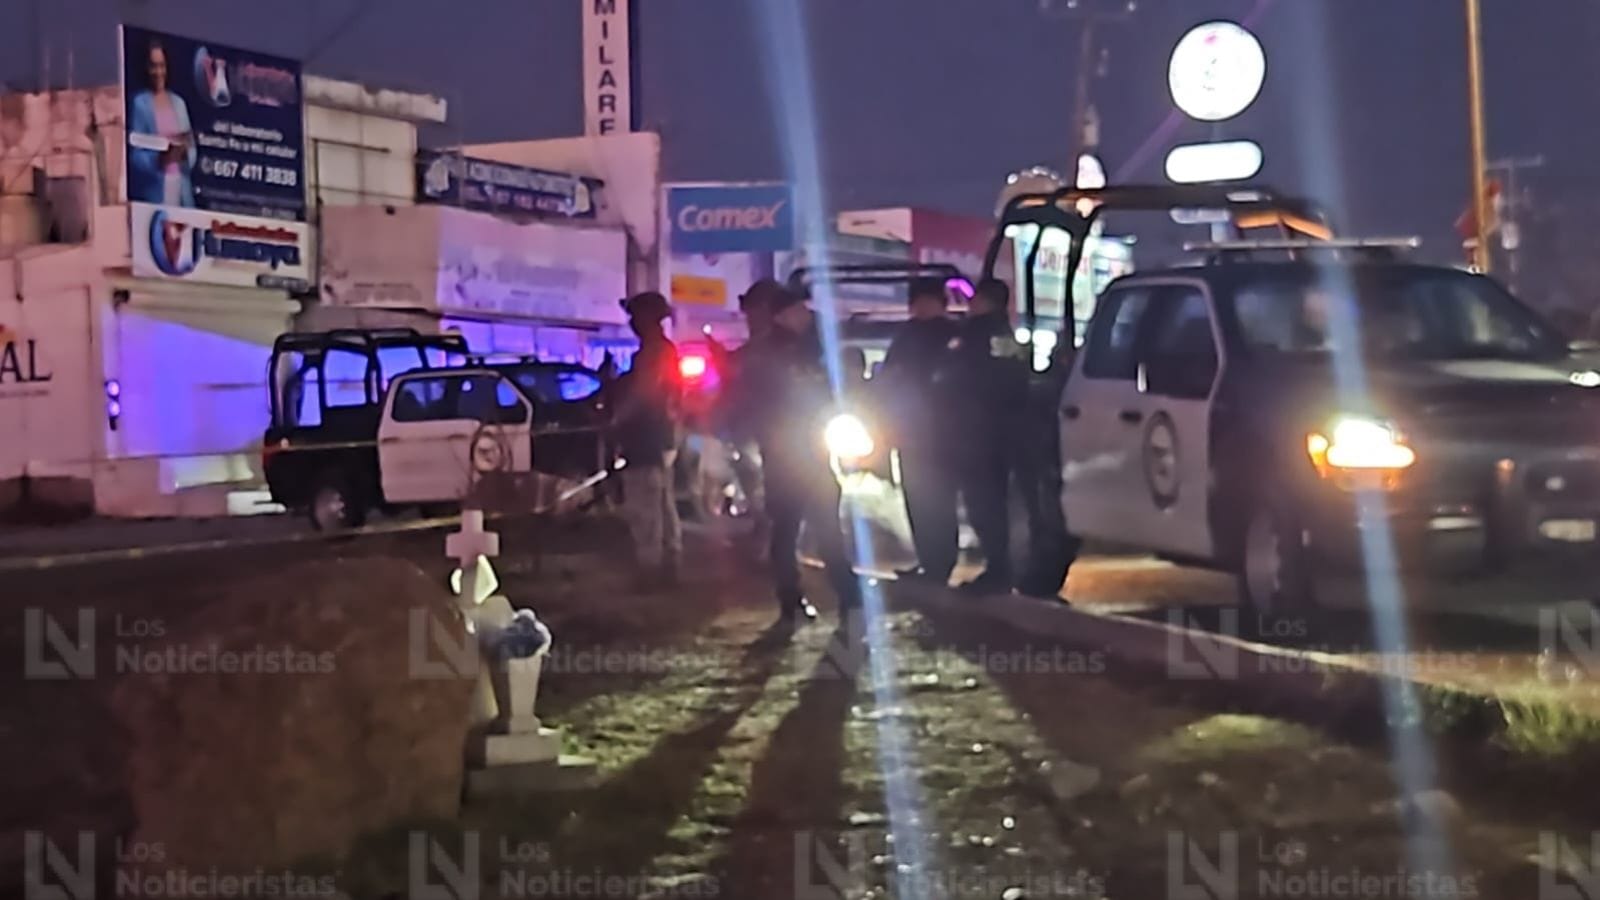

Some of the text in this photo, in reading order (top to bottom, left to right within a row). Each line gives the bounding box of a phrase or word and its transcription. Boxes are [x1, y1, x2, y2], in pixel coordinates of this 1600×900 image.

[214, 160, 238, 178] 667
[241, 164, 262, 181] 411
[678, 200, 785, 232] Comex
